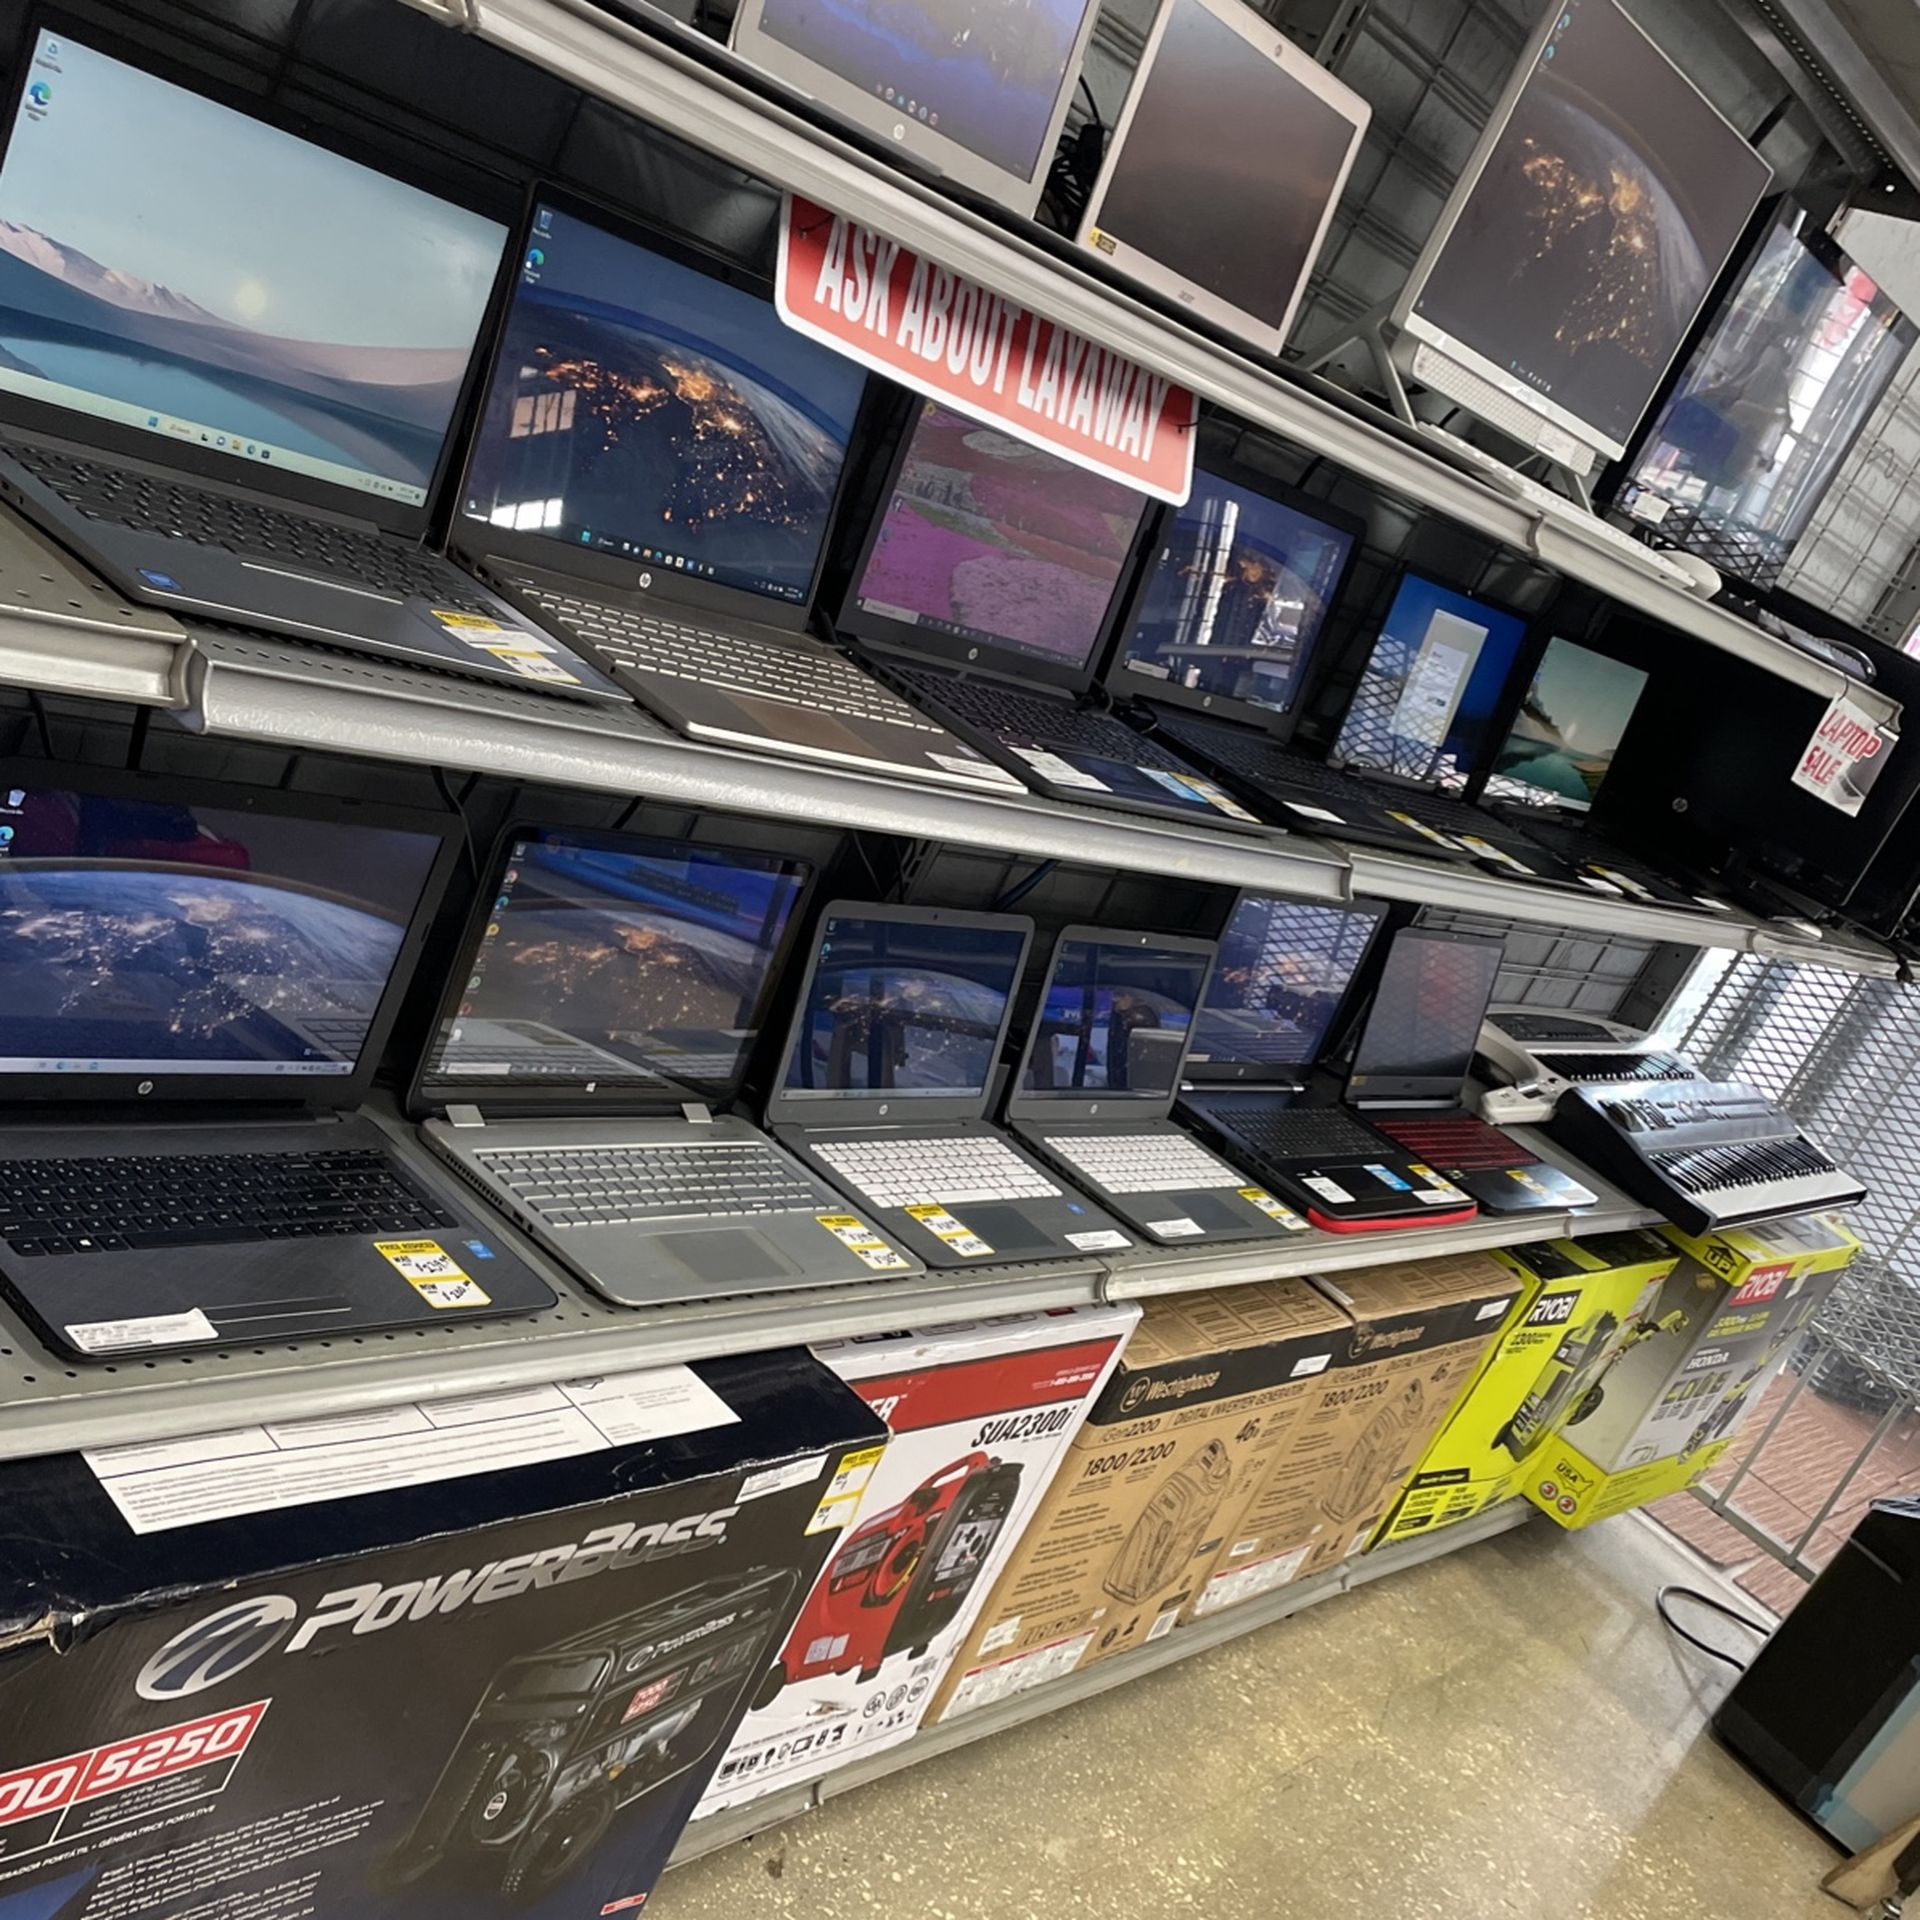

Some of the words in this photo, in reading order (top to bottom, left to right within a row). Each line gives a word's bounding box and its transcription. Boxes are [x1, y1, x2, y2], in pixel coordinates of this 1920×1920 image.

[814, 216, 900, 338] ASK
[896, 256, 1021, 394] ABOUT
[1017, 312, 1171, 462] LAYAWAY
[1818, 708, 1881, 760] LAPTOP
[1801, 745, 1842, 785] SALE
[1735, 1270, 1788, 1300] RYOBI
[1528, 1296, 1578, 1322] RYOBI
[1685, 1352, 1730, 1370] HONDA
[1147, 1370, 1221, 1401] Westinghouse
[971, 1405, 1078, 1448] SUA2300i
[1174, 1407, 1210, 1426] DIGITAL
[1209, 1395, 1253, 1418] INVERTER
[1082, 1441, 1177, 1478] 1800/2200
[1556, 1462, 1579, 1483] USA
[284, 1506, 739, 1653] POWERBOSS
[86, 1714, 252, 1791] 5250
